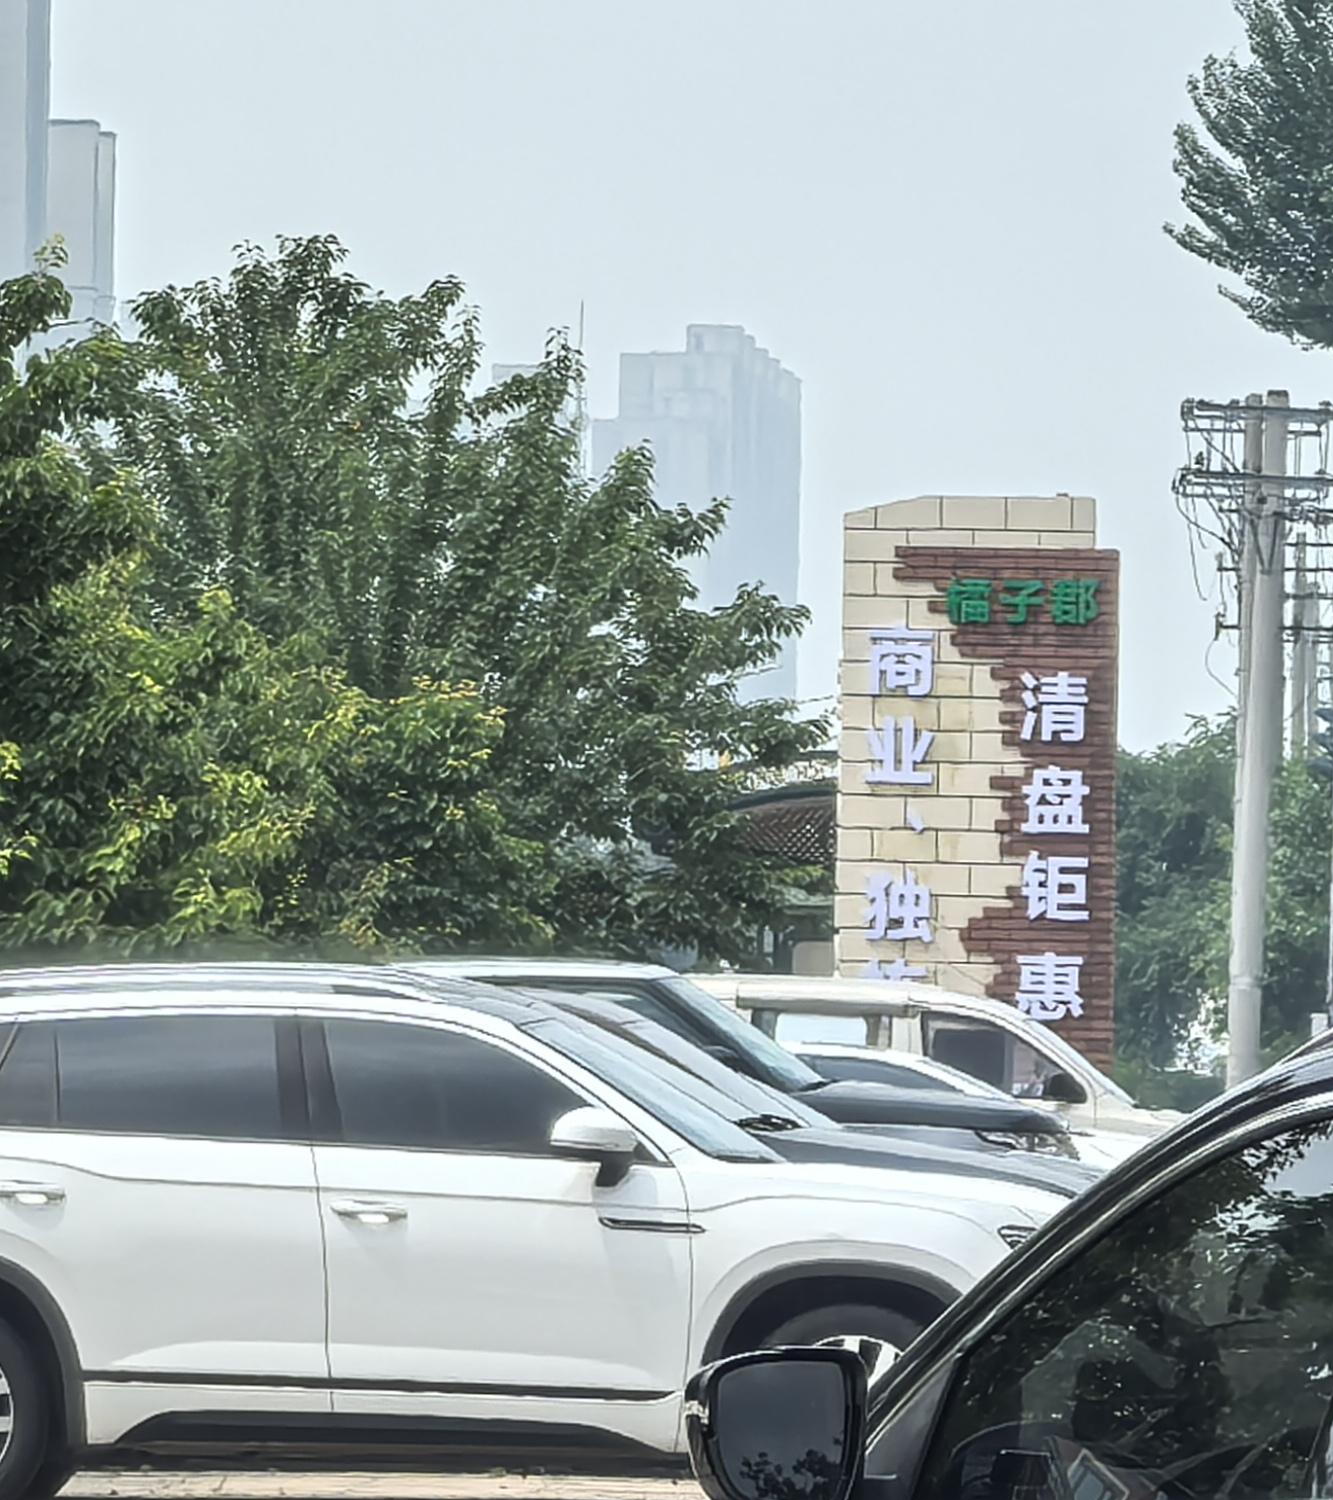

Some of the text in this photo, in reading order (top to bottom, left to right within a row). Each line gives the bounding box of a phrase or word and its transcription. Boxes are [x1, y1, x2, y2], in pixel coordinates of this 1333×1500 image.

[863, 625, 935, 981] 商业、独
[1015, 671, 1091, 1021] 清盘钜惠
